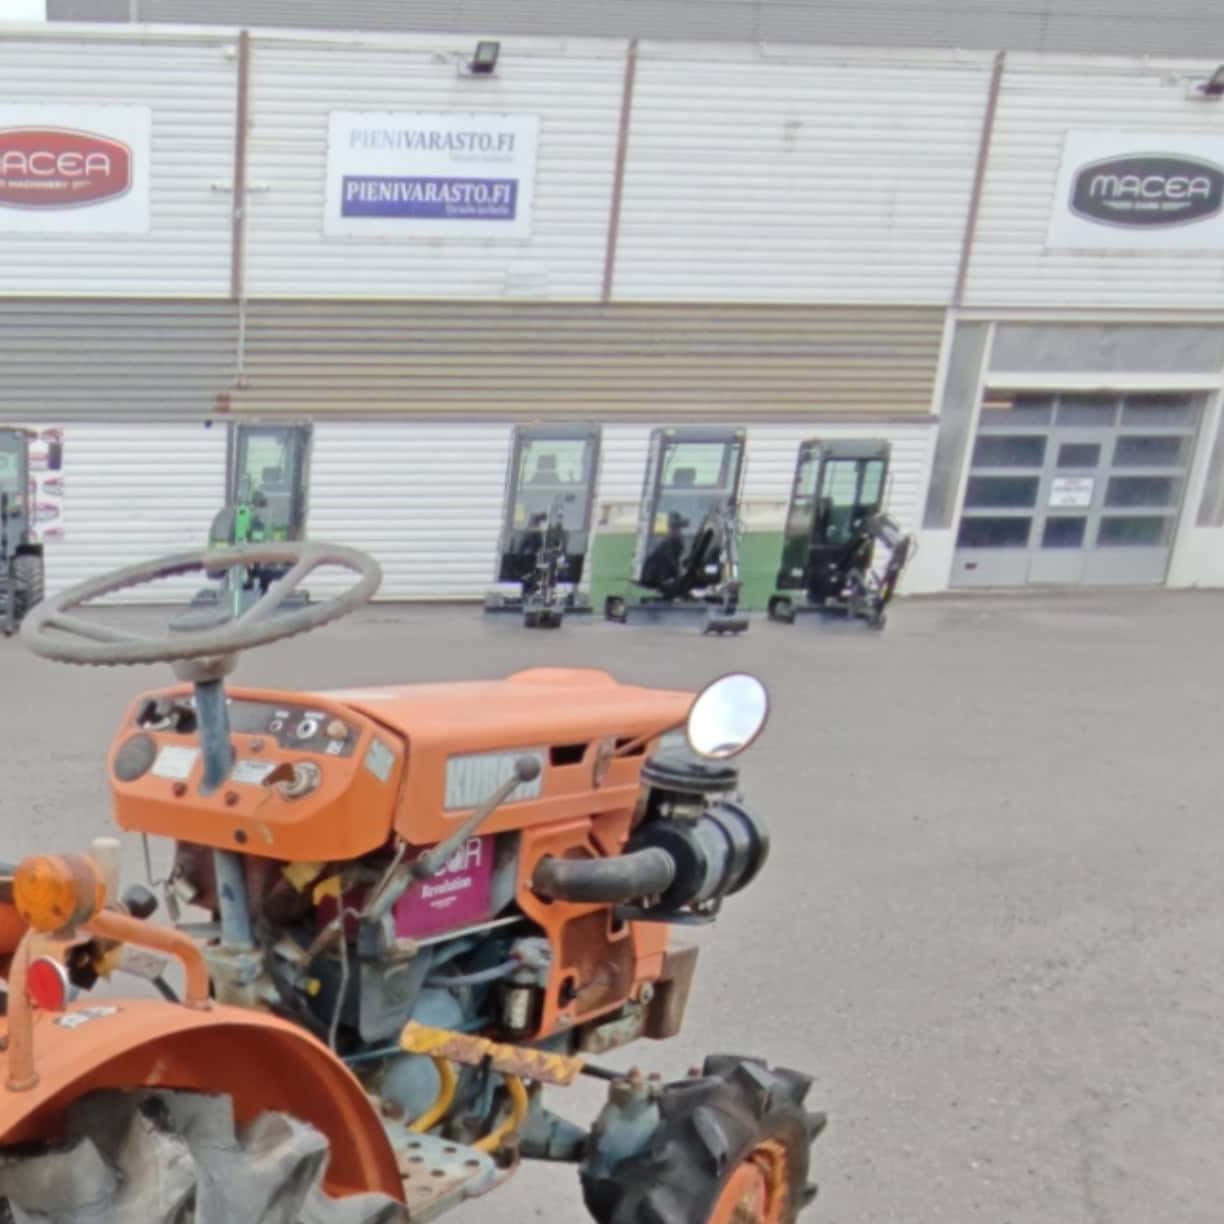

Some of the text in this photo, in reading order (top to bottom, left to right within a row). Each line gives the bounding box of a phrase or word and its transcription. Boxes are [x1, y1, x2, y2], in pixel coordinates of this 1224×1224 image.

[349, 128, 516, 152] PIENIVARASTO.FI
[346, 181, 511, 204] PIENIVARASTO.FI
[1089, 174, 1212, 199] MACEA
